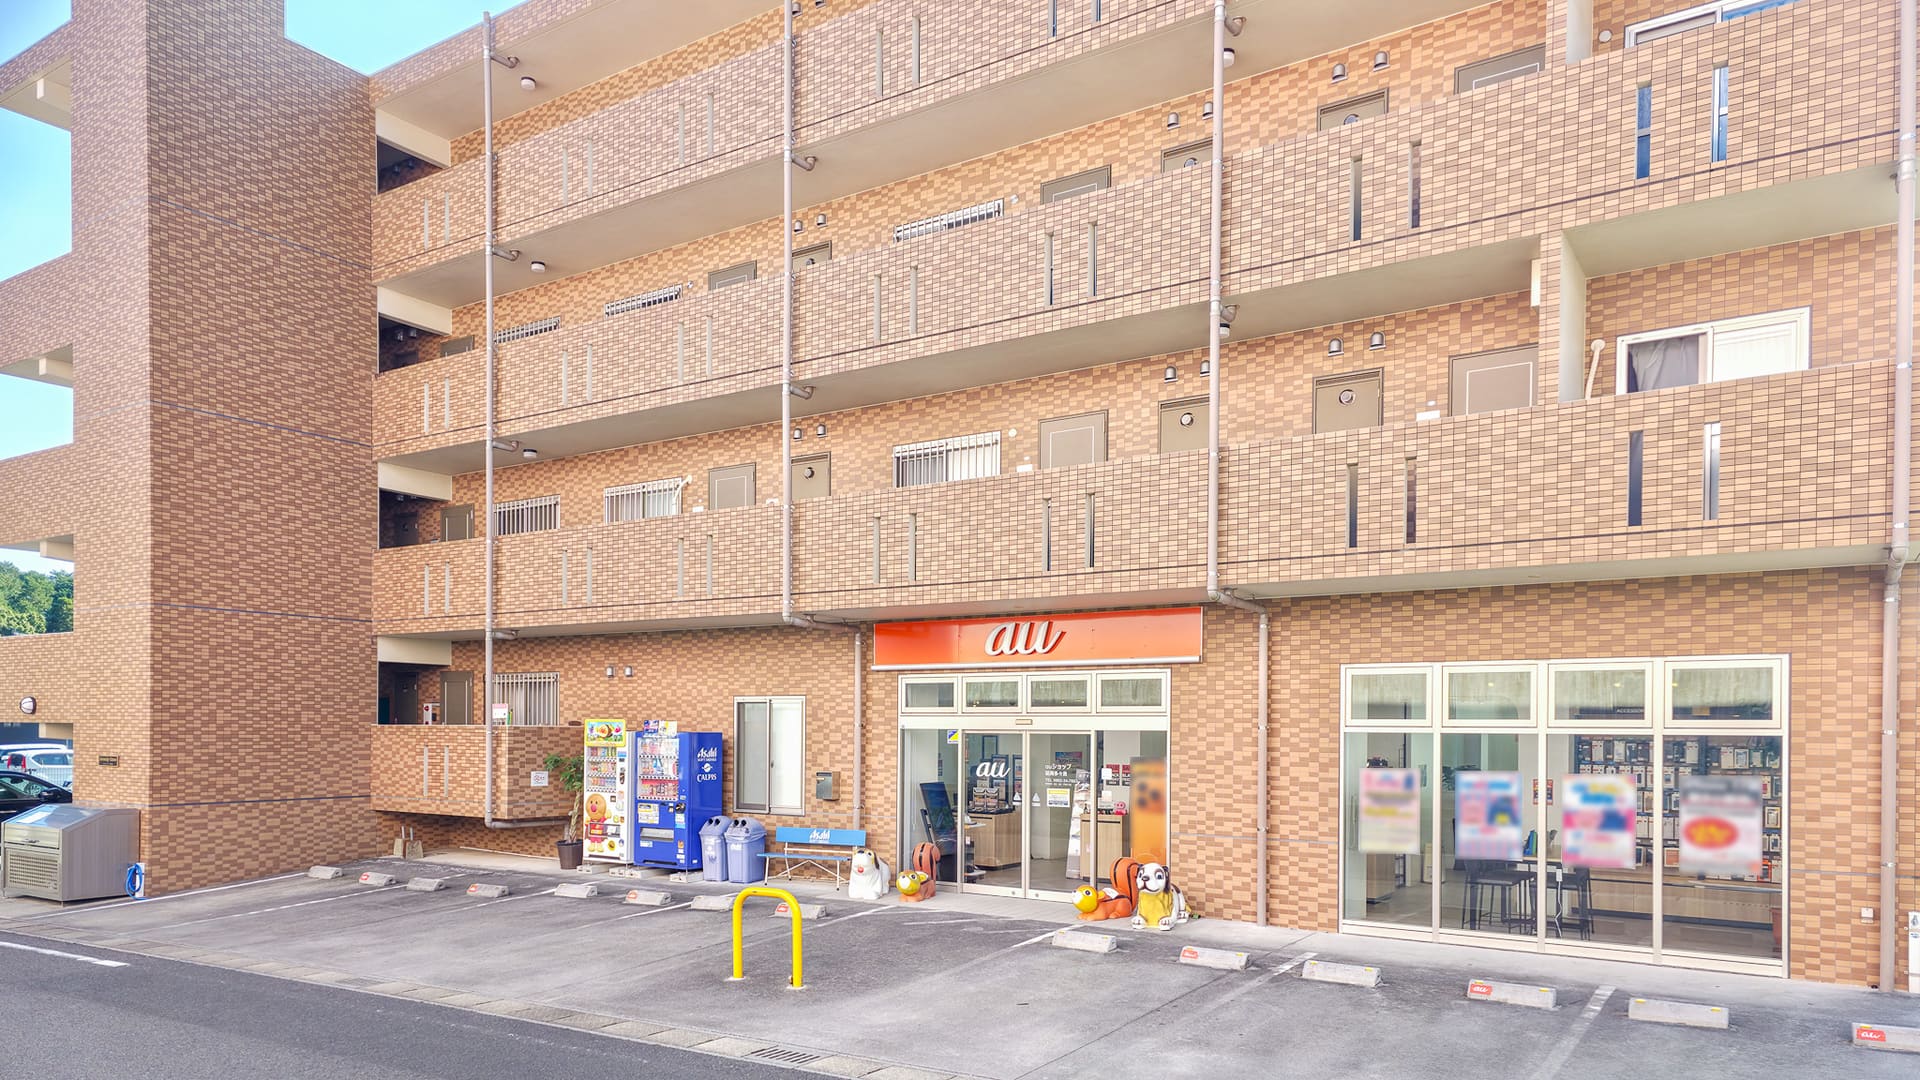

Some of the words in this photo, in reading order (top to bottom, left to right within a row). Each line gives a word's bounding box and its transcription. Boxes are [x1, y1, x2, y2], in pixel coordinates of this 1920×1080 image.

[985, 621, 1064, 656] au
[697, 747, 718, 758] Asahi
[975, 761, 1011, 778] au
[696, 773, 717, 783] CALPIS
[809, 828, 830, 840] Asahi
